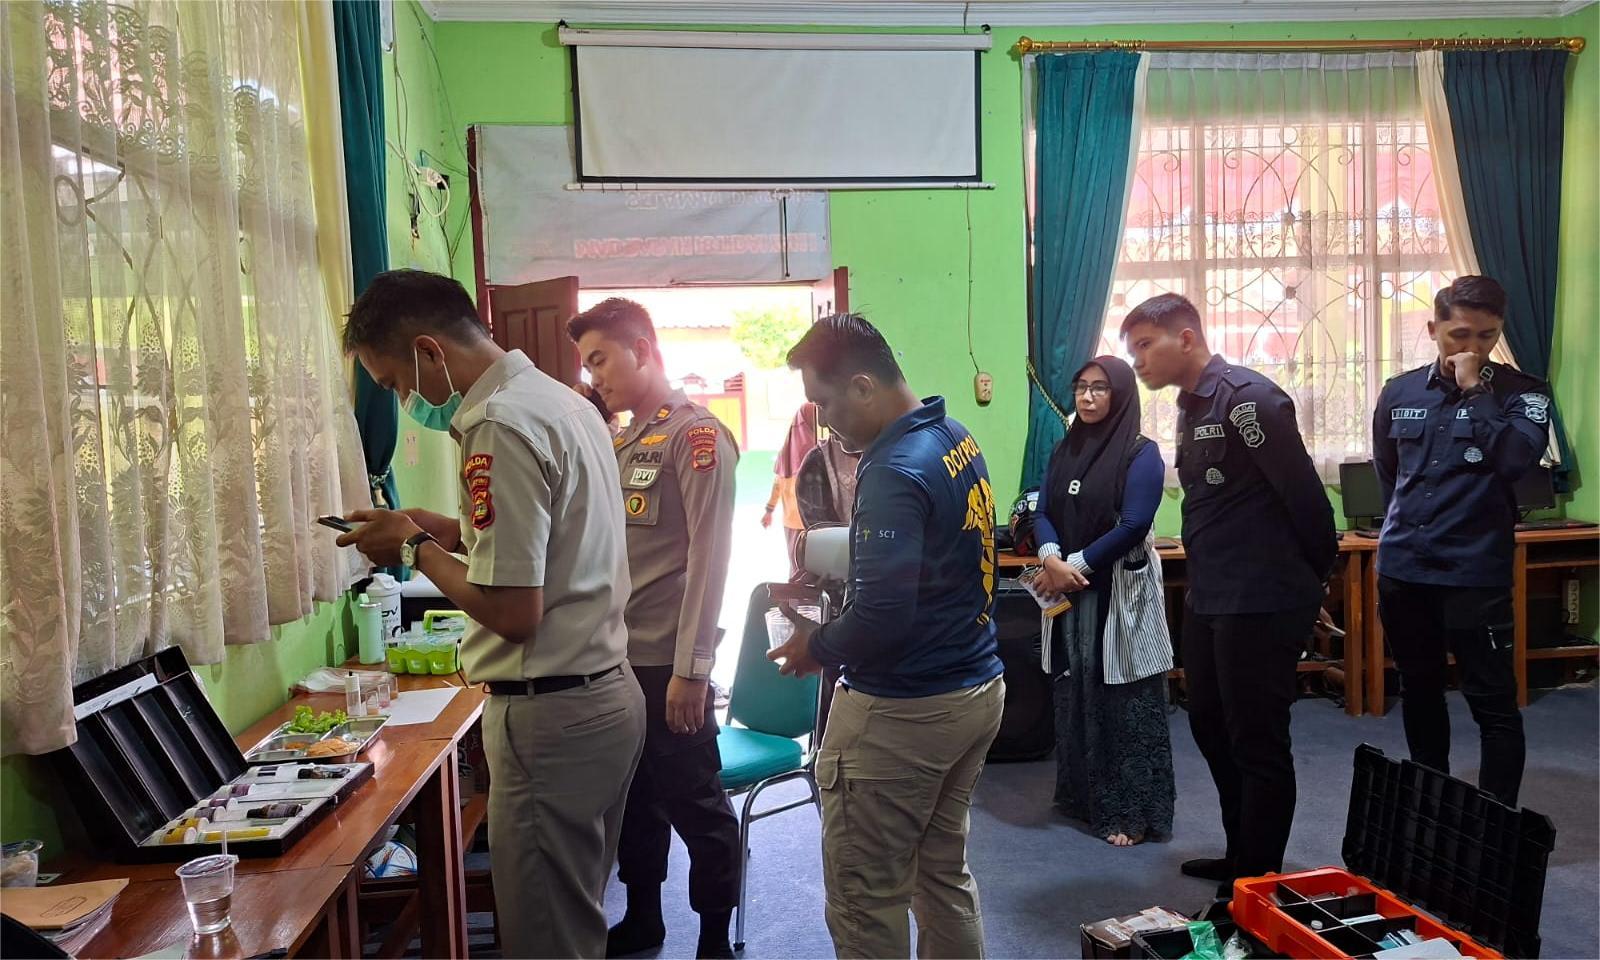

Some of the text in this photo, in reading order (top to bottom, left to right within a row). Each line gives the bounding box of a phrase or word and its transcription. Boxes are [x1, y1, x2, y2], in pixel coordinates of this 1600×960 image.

[688, 427, 715, 439] POLDA
[1195, 427, 1220, 438] POLRI
[630, 451, 663, 465] POLRI
[635, 470, 654, 481] DVI
[877, 530, 895, 539] SCI
